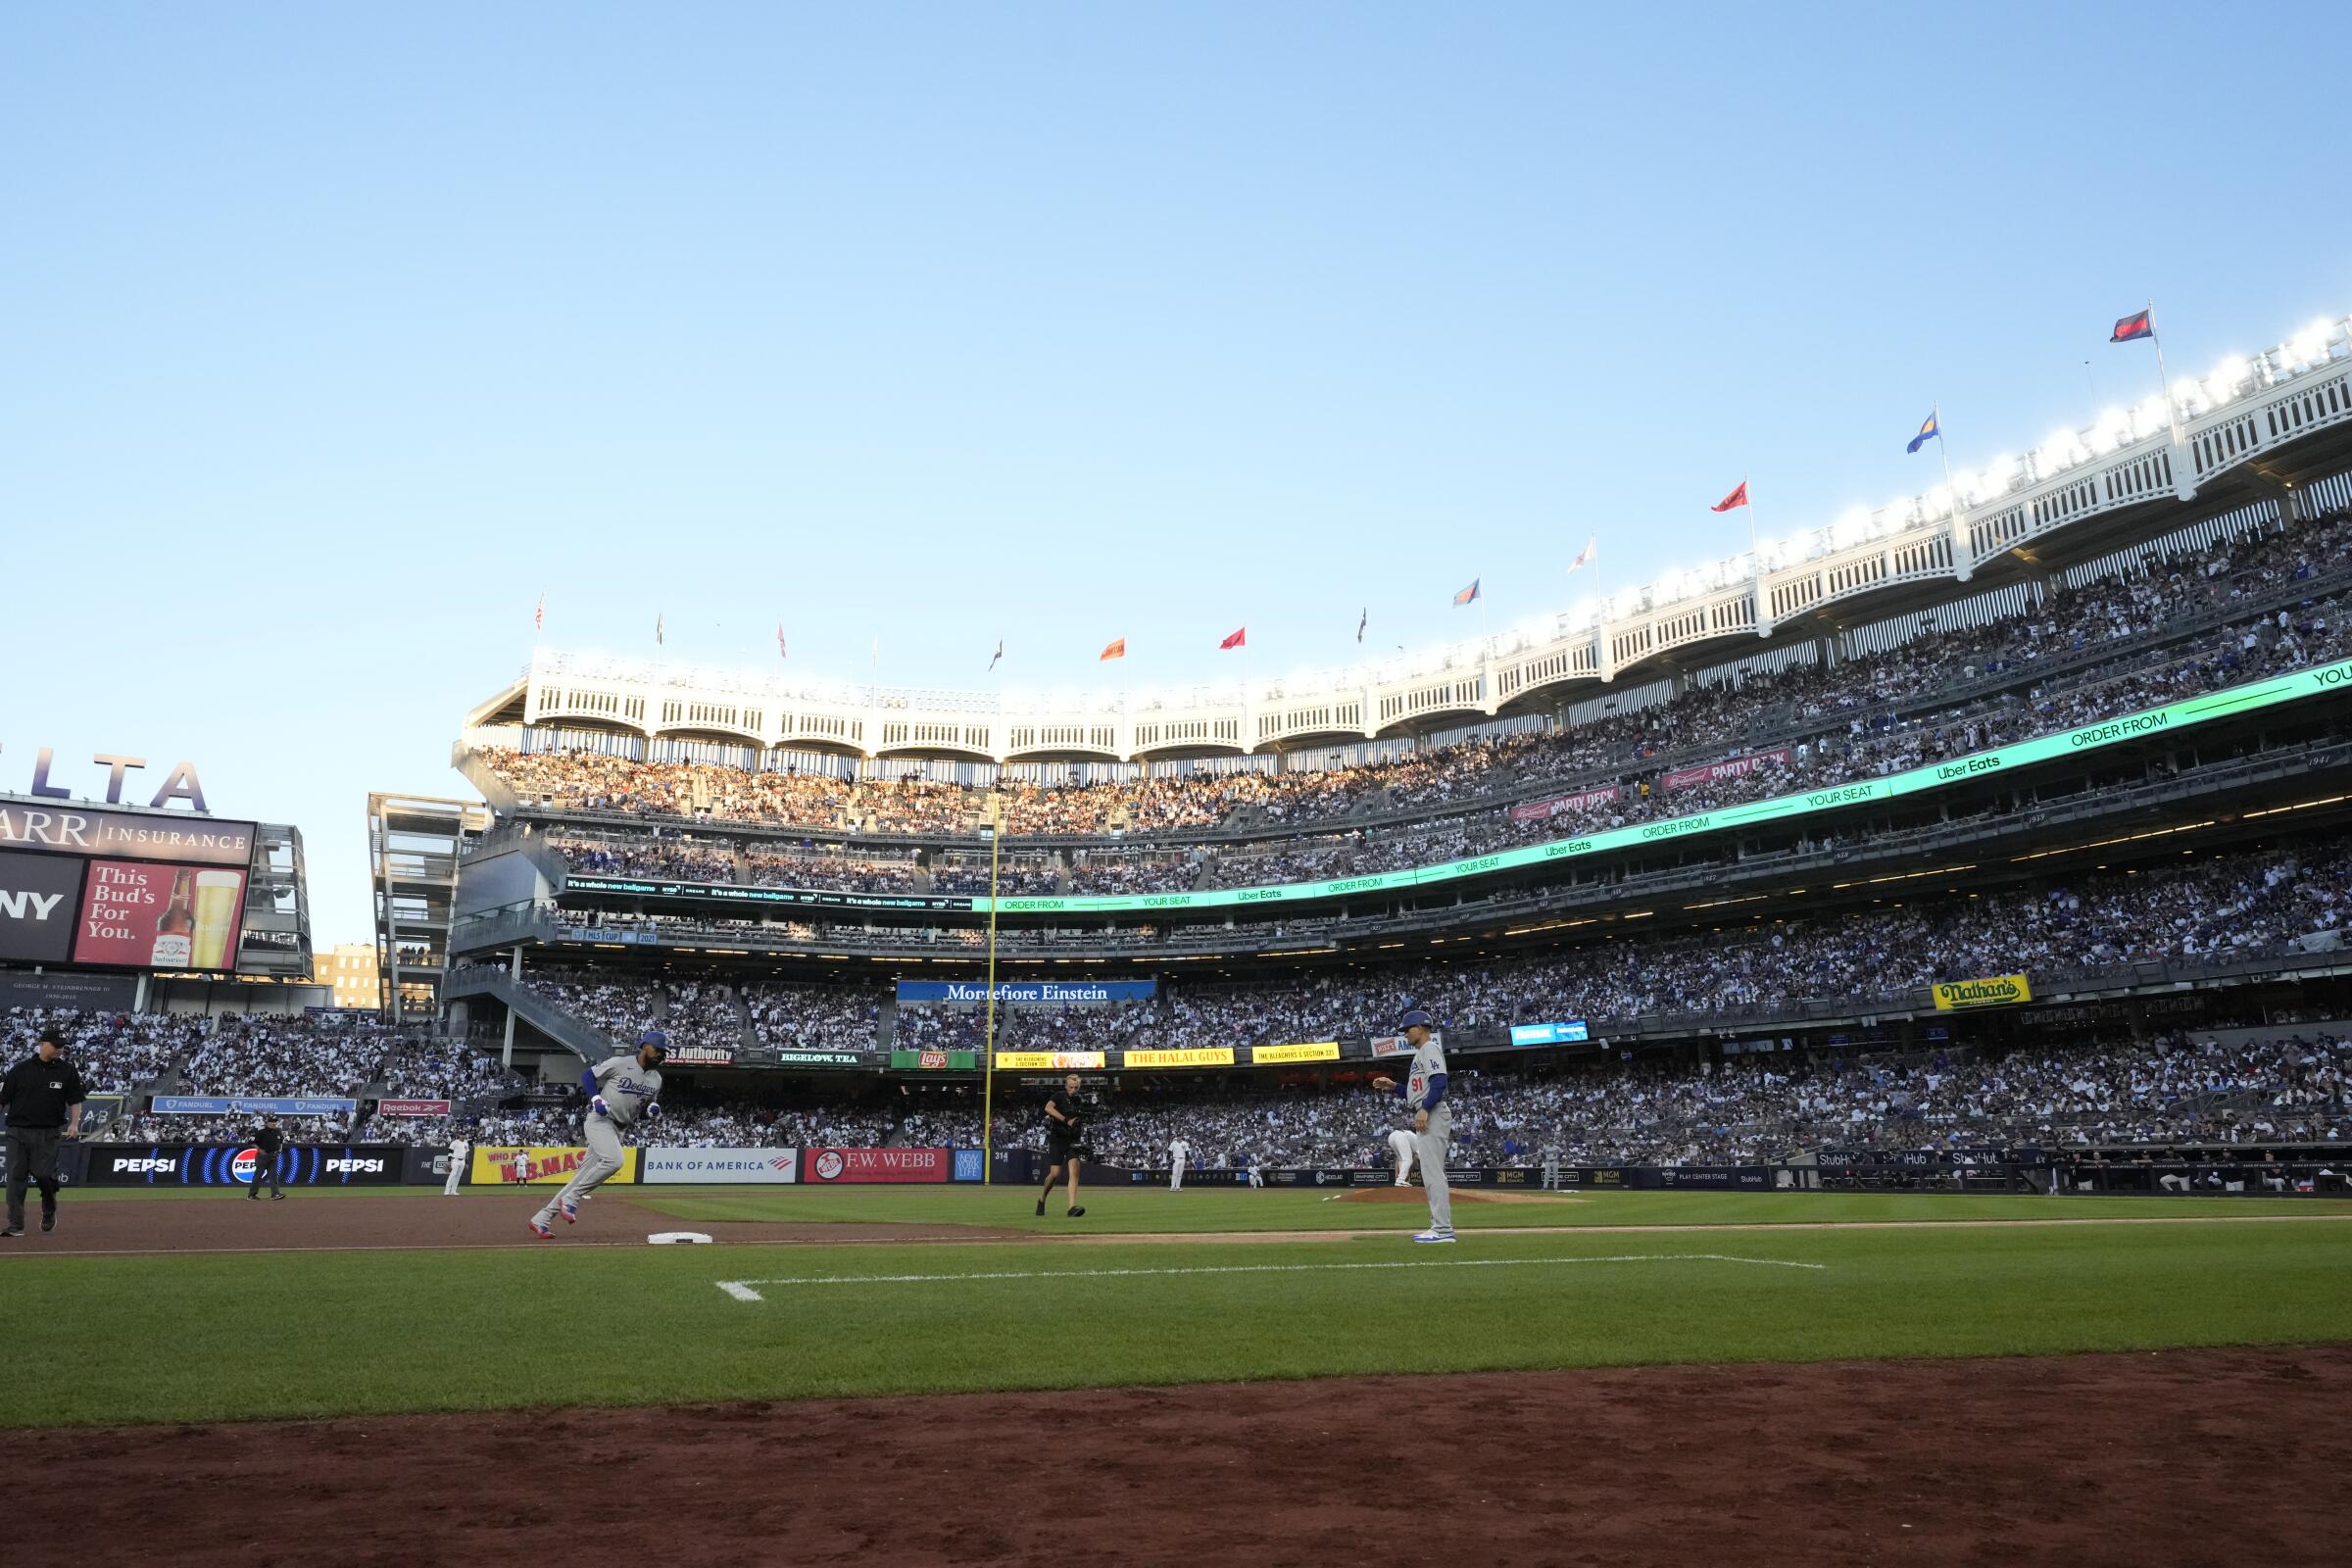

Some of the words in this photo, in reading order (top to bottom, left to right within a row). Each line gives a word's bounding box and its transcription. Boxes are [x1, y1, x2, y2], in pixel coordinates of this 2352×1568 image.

[2071, 725, 2121, 747] ORDER
[2122, 712, 2168, 736] FROM
[1711, 760, 1749, 781] PARTY
[1936, 765, 1967, 780] Uber
[1968, 757, 2000, 772] Eats
[1806, 792, 1841, 808] YOUR
[1842, 785, 1873, 801] SEAT
[1642, 824, 1678, 839] ORDER
[1678, 816, 1710, 831] FROM
[106, 826, 246, 850] INSURANCE
[1545, 845, 1568, 857] Uber
[1568, 841, 1592, 853] Eats
[1454, 860, 1480, 874] YOUR
[1480, 857, 1499, 869] SEAT
[96, 866, 148, 886] This
[567, 879, 579, 888] It's
[623, 883, 656, 892] ballgame
[1328, 879, 1357, 893] ORDER
[1357, 877, 1383, 889] FROM
[93, 885, 155, 905] Bud's
[763, 891, 794, 900] ballgame
[1143, 897, 1168, 906] YOUR
[1169, 896, 1192, 906] SEAT
[1238, 891, 1260, 901] Uber
[1260, 889, 1282, 900] Eats
[896, 899, 926, 907] ballgame
[1004, 901, 1036, 909] ORDER
[1037, 900, 1064, 909] FROM
[89, 903, 130, 921] For
[87, 920, 136, 940] You.
[588, 930, 601, 940] MLS
[606, 932, 618, 941] CUP
[640, 933, 655, 943] 2021
[1042, 984, 1108, 1001] Einstein
[1940, 979, 2020, 1001] Nathan's
[678, 1046, 733, 1060] Authority
[835, 1054, 858, 1063] TEA
[921, 1052, 948, 1067] Lay's
[1131, 1053, 1155, 1063] THE
[1158, 1052, 1197, 1063] HALAL
[1199, 1051, 1228, 1061] GUYS
[1269, 1051, 1298, 1059] BLEACHERS
[1303, 1050, 1324, 1058] SECTION
[1429, 1059, 1441, 1070] LA
[1411, 1077, 1423, 1092] 91
[383, 1103, 421, 1112] Reebok
[847, 1152, 877, 1167] F.W.
[883, 1152, 935, 1168] WEBB
[995, 1152, 1008, 1160] 314
[113, 1158, 176, 1172] PEPSI
[326, 1158, 384, 1172] PEPSI
[647, 1161, 683, 1170] BANK
[687, 1161, 704, 1170] OF
[707, 1161, 764, 1170] AMERICA
[957, 1160, 979, 1169] YORK
[959, 1168, 977, 1177] LIFE
